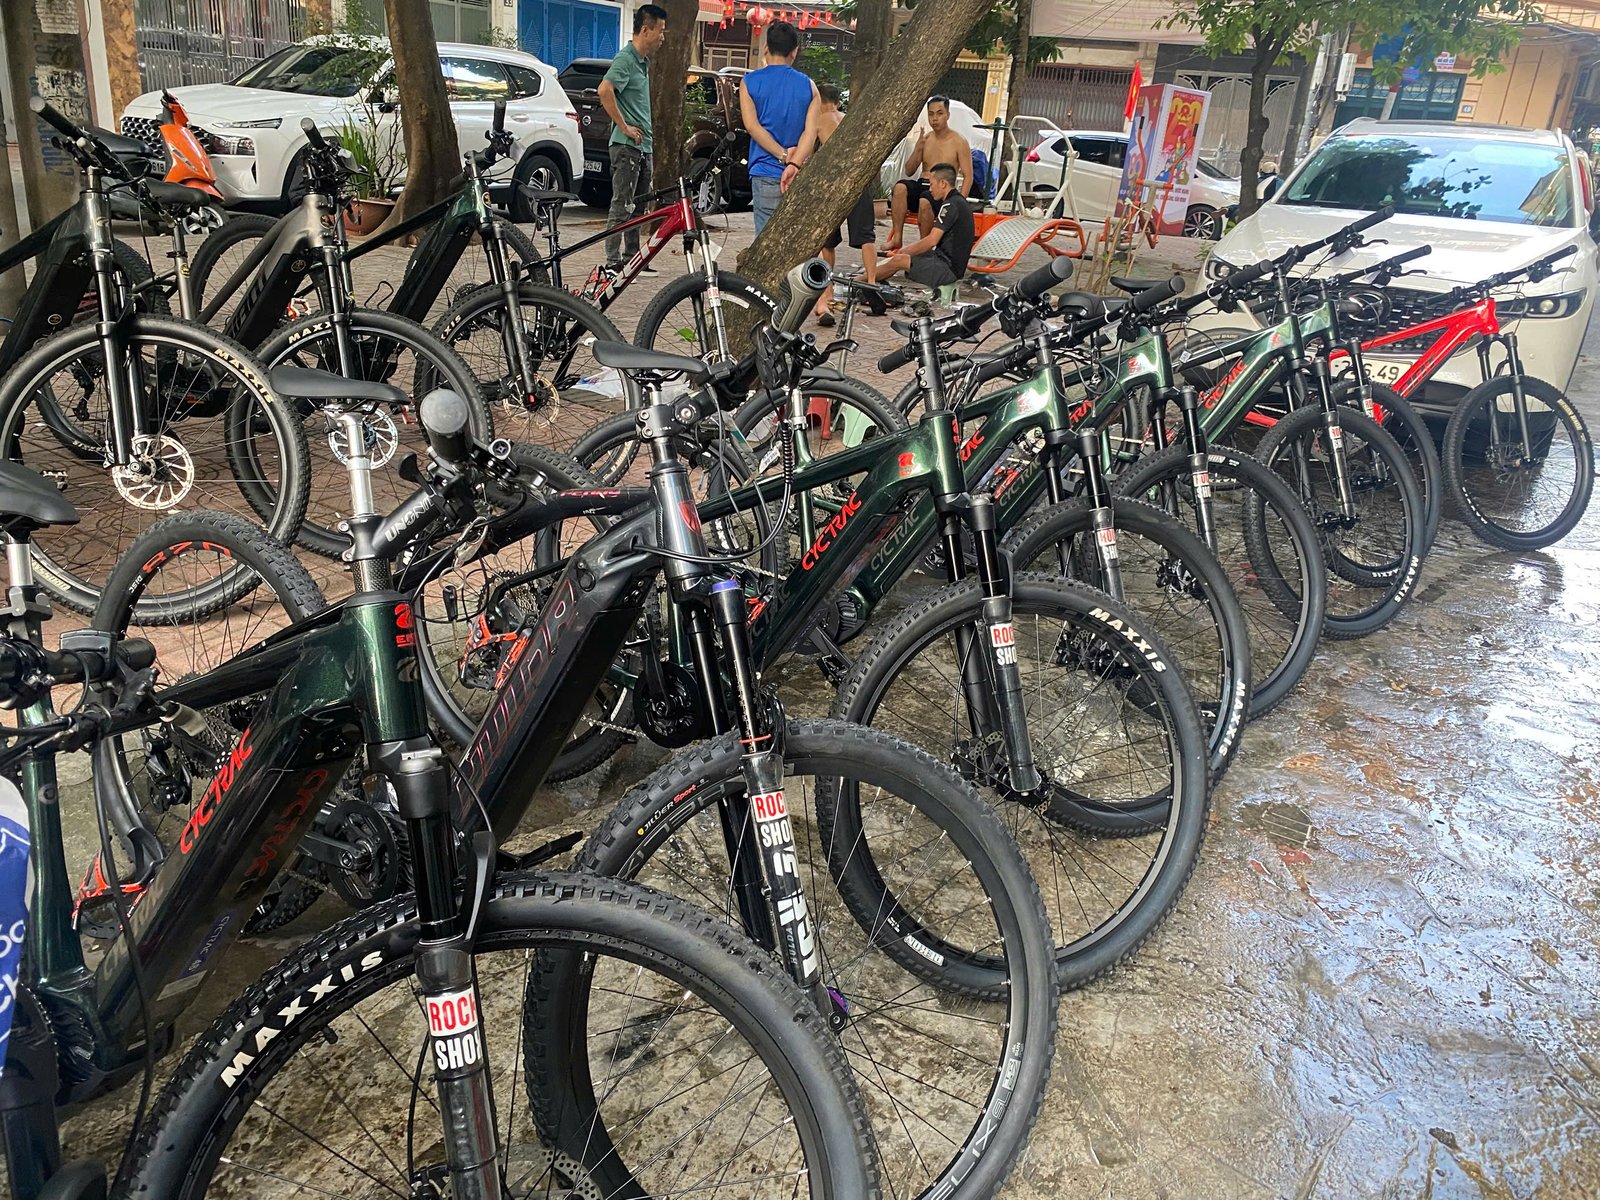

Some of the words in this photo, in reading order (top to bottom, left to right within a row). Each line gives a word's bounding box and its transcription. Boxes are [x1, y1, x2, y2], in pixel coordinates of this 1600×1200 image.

[592, 233, 664, 311] TREK
[213, 348, 274, 403] MAXXIS
[1203, 359, 1248, 410] CYCTRAC
[801, 491, 862, 571] CYCTRAC
[870, 508, 920, 572] CYCTRAC
[128, 574, 143, 594] DISC
[1394, 555, 1420, 604] MAXXIS
[1088, 607, 1166, 672] MAXXIS
[1218, 679, 1246, 757] MAXXIS
[179, 727, 253, 855] CYCTRAC
[755, 792, 785, 820] ROC
[760, 819, 792, 848] SHO
[784, 926, 798, 965] HULDA
[220, 950, 384, 1089] MAXXIS
[928, 1118, 999, 1200] ELIX
